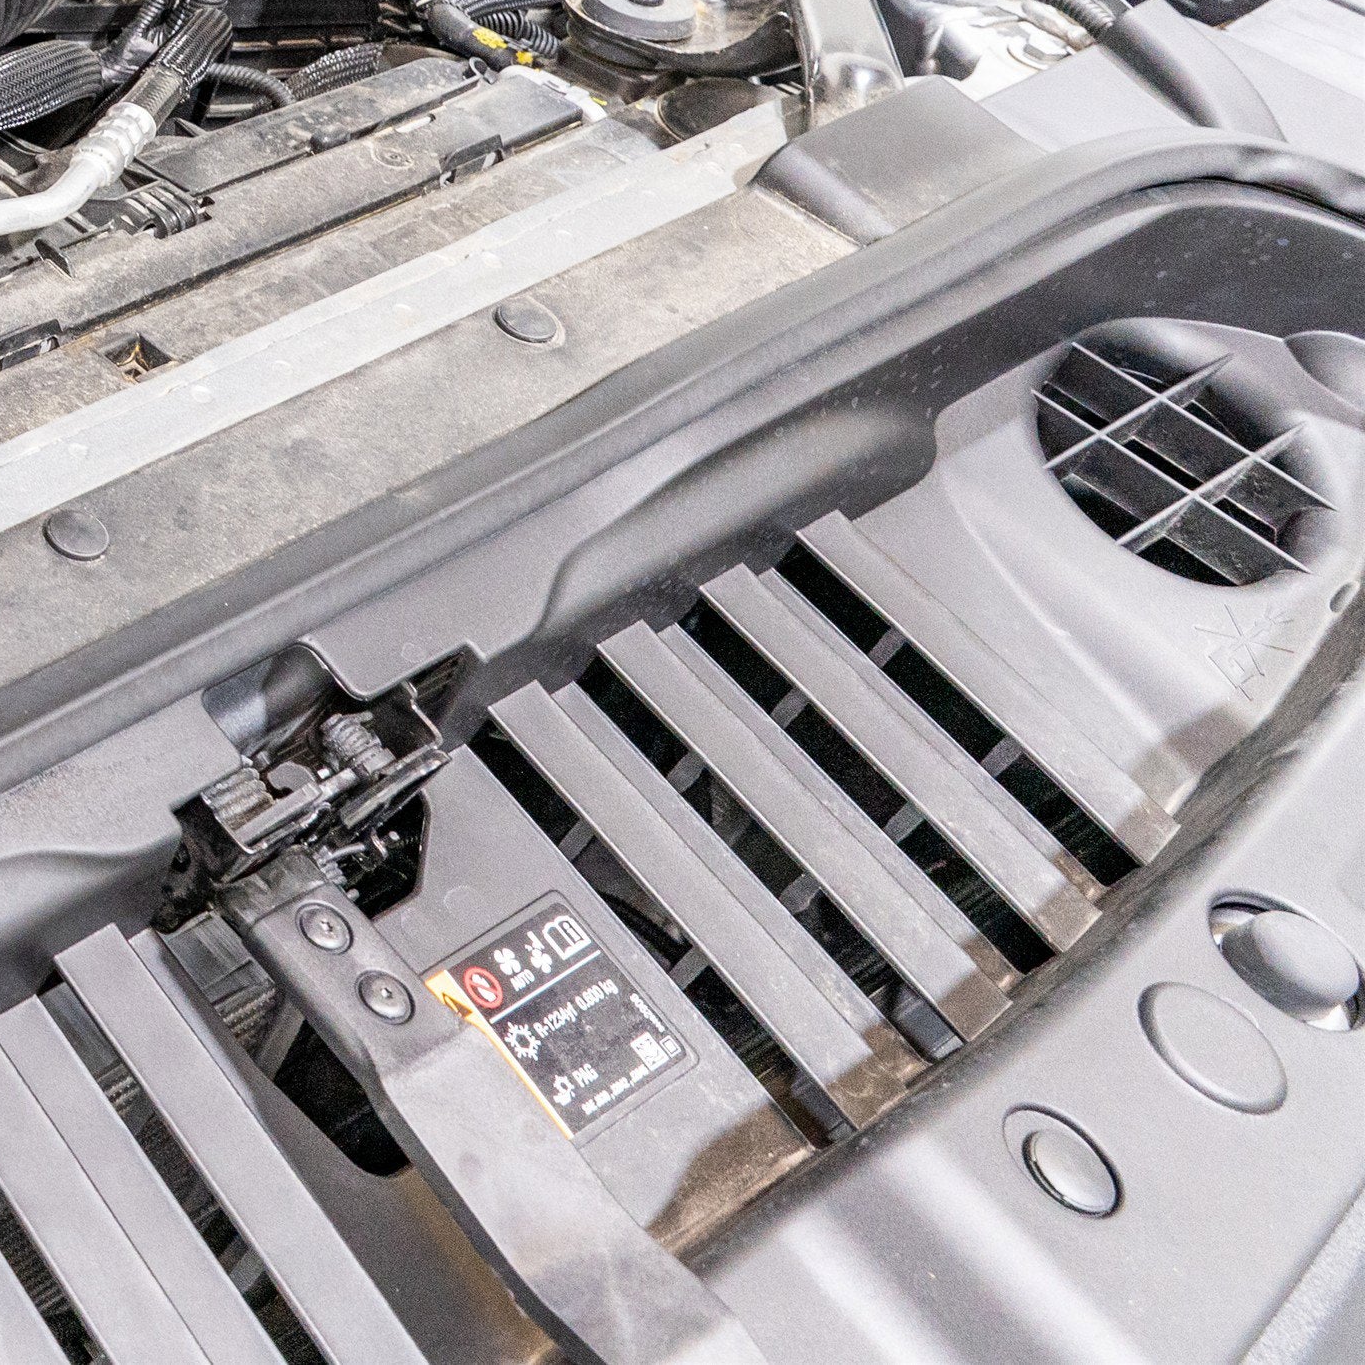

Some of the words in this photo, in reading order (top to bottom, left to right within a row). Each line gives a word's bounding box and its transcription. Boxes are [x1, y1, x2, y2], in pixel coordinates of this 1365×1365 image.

[510, 969, 535, 992] AUTO
[533, 1001, 578, 1038] R-1234yf
[574, 984, 605, 1011] 0.600
[598, 978, 619, 995] kg
[571, 1063, 599, 1088] PAG
